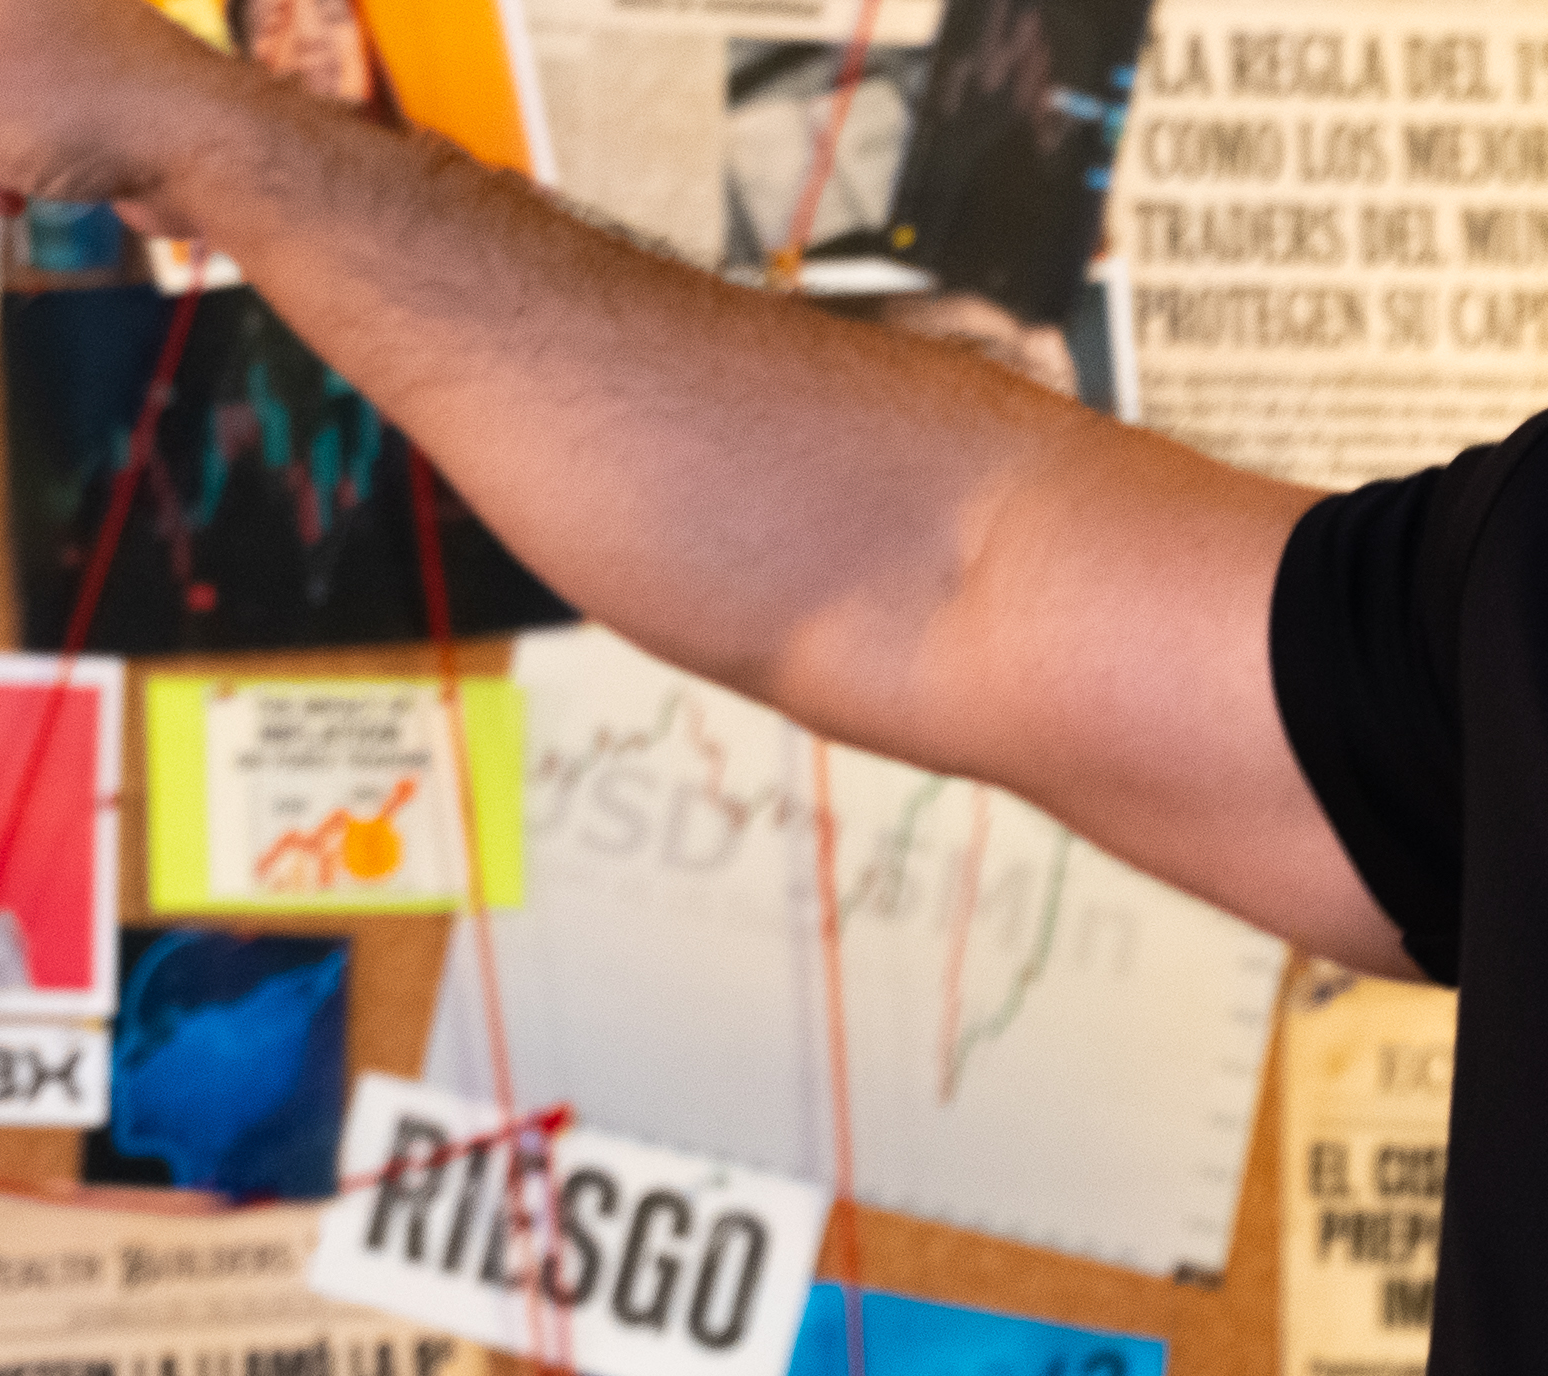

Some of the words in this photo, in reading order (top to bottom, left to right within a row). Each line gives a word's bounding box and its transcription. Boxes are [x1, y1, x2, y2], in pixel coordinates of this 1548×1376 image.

[1151, 31, 1213, 100] LA
[1225, 32, 1391, 103] REGLA
[1401, 36, 1502, 105] DEL
[1139, 115, 1284, 185] COMO
[1295, 118, 1390, 185] LOS
[1132, 201, 1347, 269] TRADERS
[1359, 205, 1446, 272] DEL
[1135, 287, 1369, 353] PROTEGEN
[1380, 289, 1439, 351] SU
[1307, 1142, 1351, 1198] EL
[364, 1109, 773, 1353] RIESGO
